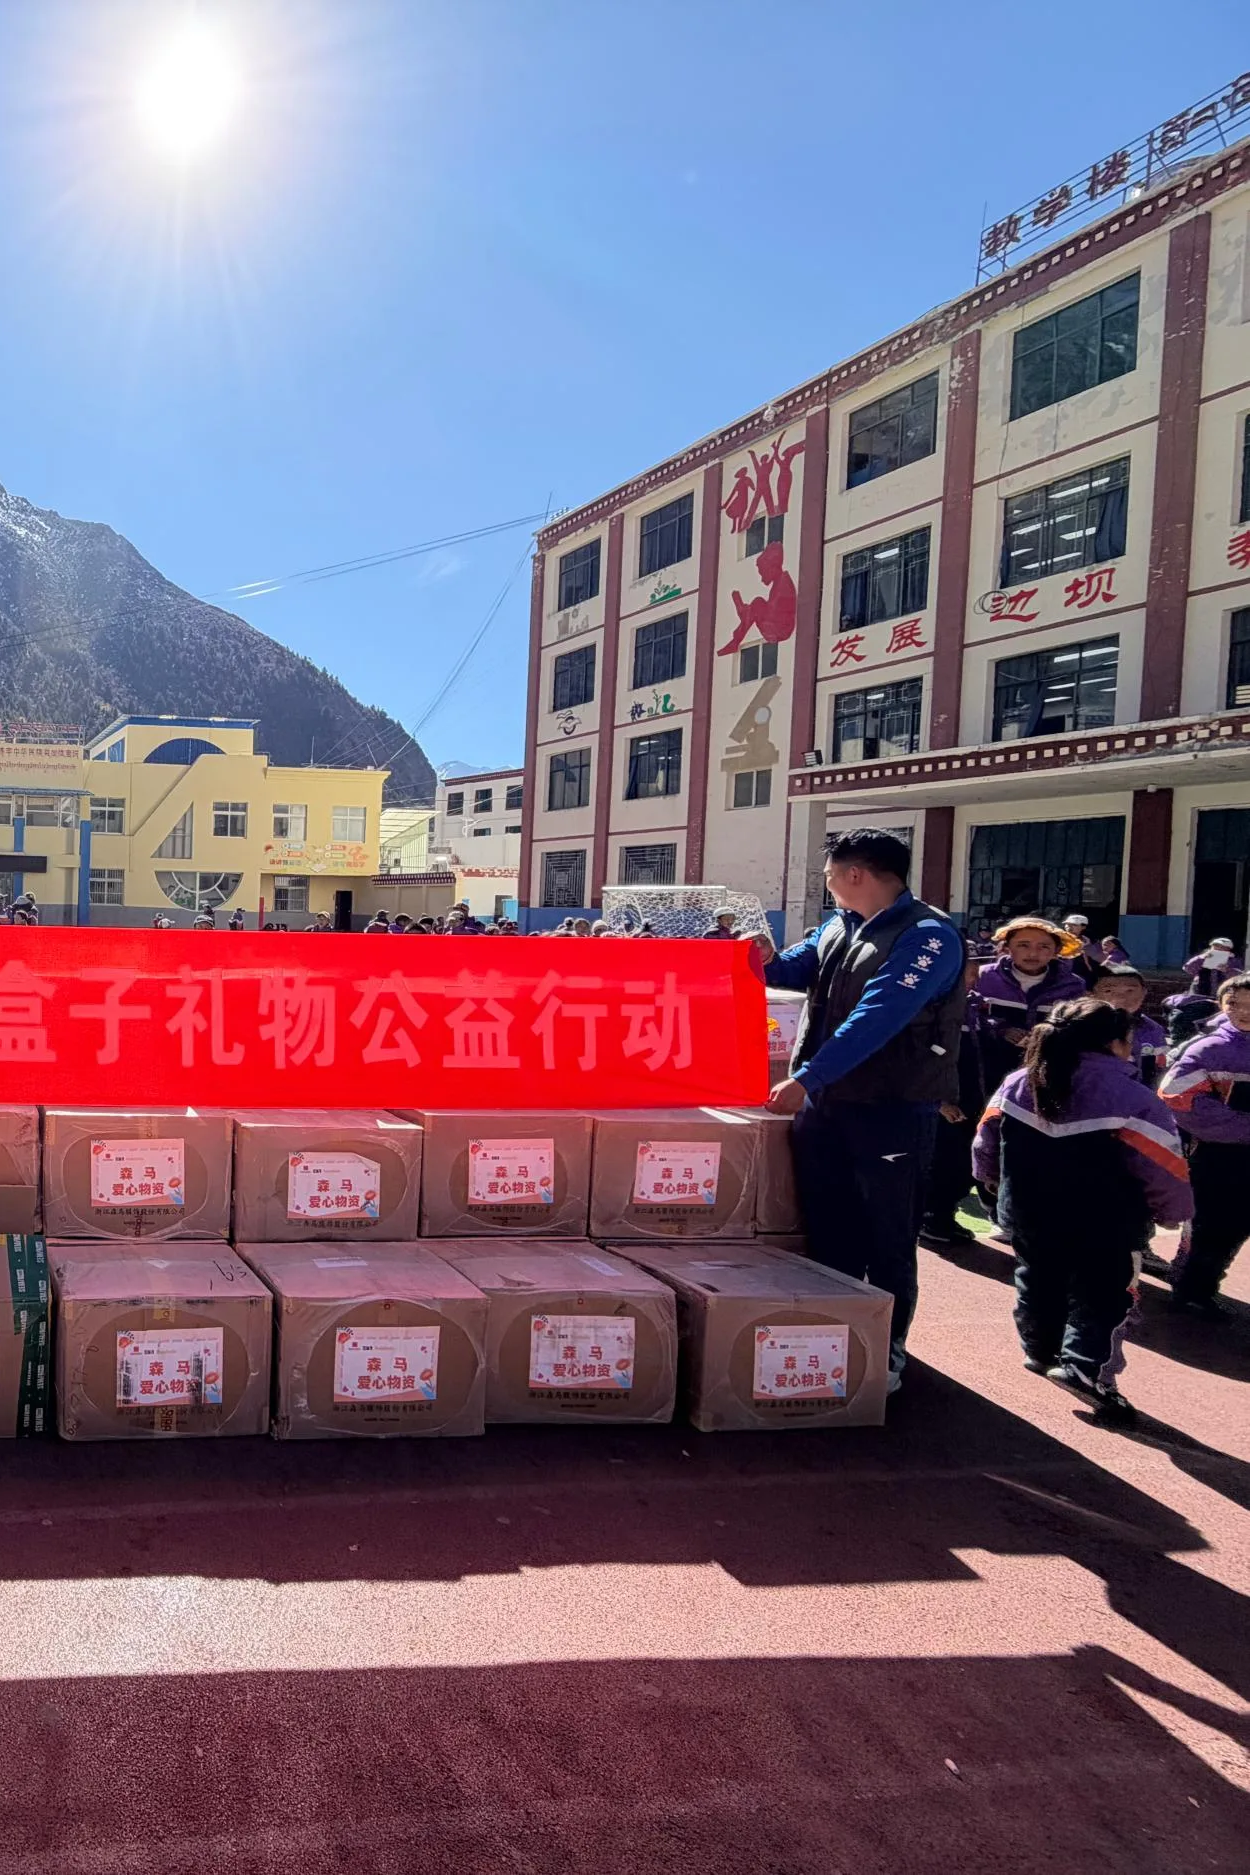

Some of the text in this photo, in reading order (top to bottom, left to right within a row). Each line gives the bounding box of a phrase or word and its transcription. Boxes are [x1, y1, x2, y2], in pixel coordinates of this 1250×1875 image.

[982, 149, 1132, 258] 教学楼
[829, 567, 1119, 668] 发展 边坝
[120, 1166, 156, 1180] 森马
[495, 1165, 529, 1178] 森马
[661, 1167, 694, 1180] 森马
[111, 1182, 165, 1196] 爱心物资
[317, 1178, 353, 1192] 森马
[487, 1181, 536, 1194] 爱心物资
[653, 1182, 700, 1195] 爱心物资
[309, 1195, 360, 1208] 爱心物资
[562, 1345, 603, 1361] 森马
[148, 1360, 191, 1377] 森马
[366, 1356, 408, 1373] 森马
[783, 1355, 820, 1370] 森马
[552, 1363, 611, 1377] 爱心物资
[357, 1375, 415, 1390] 爱心物资
[774, 1372, 828, 1388] 爱心物资
